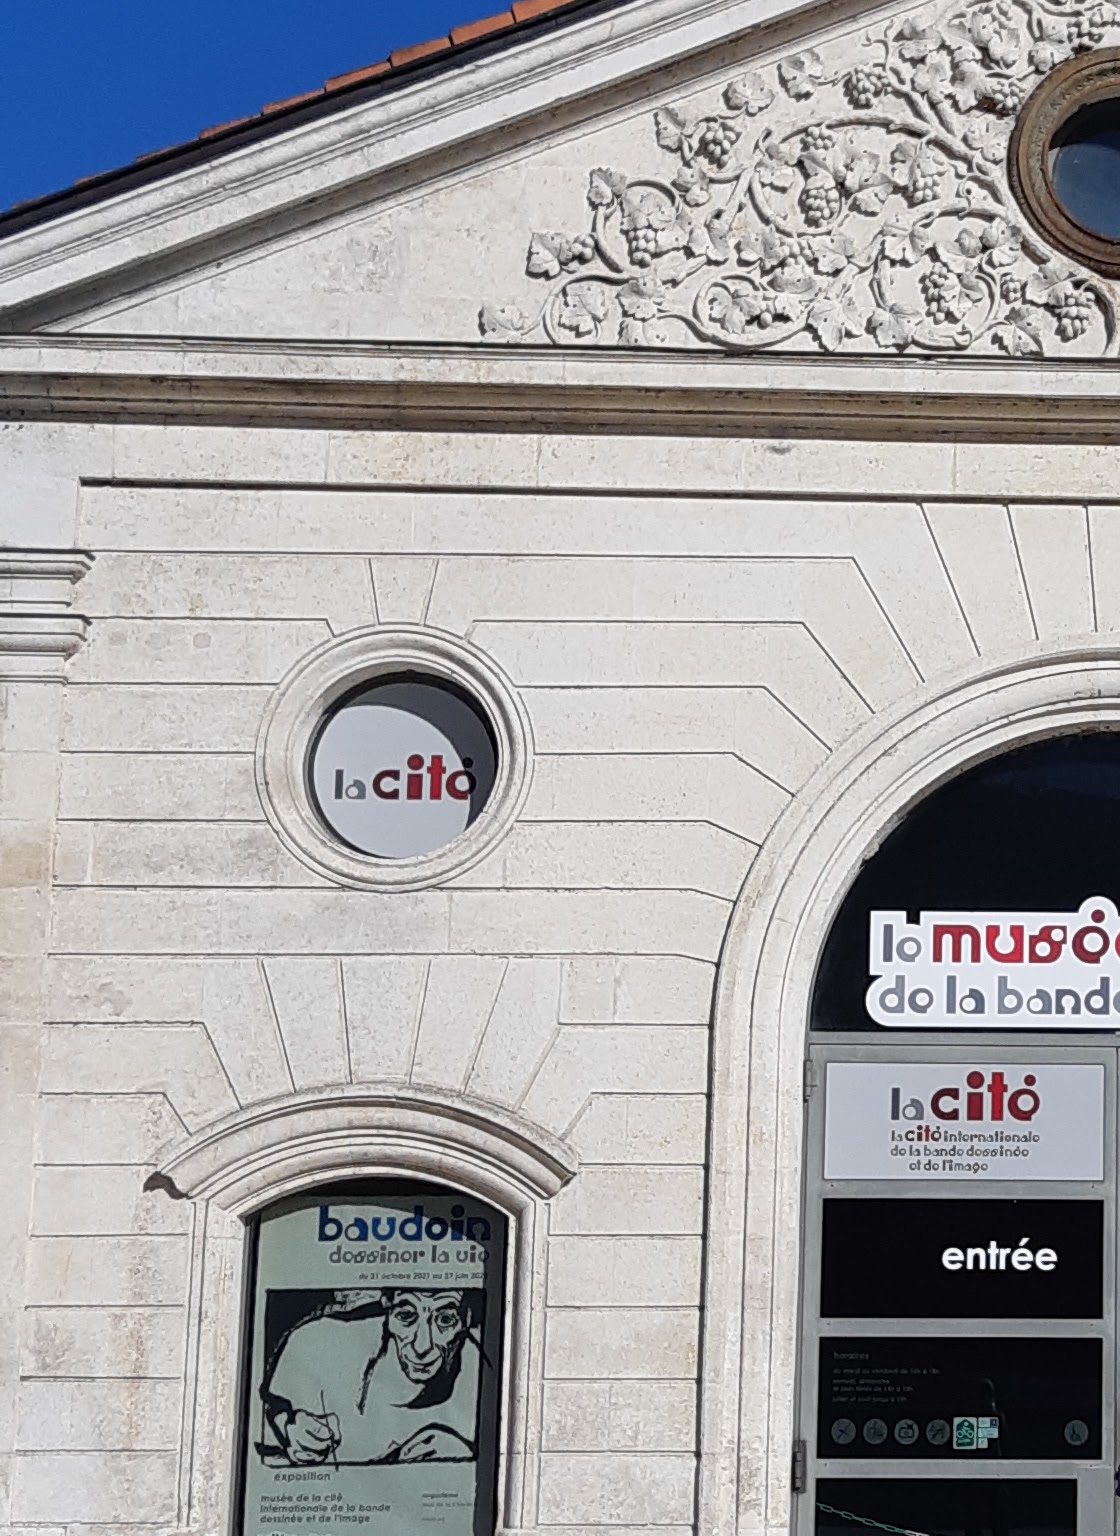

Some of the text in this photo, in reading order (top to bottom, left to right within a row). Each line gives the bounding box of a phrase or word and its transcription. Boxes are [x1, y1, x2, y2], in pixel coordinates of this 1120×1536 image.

[334, 769, 366, 800] la
[946, 975, 986, 1015] la
[891, 1087, 925, 1121] la
[891, 1130, 903, 1142] la
[909, 1145, 921, 1157] la
[318, 1204, 491, 1242] baudoin
[431, 1244, 450, 1263] la
[942, 1237, 1058, 1271] entrée
[274, 1471, 331, 1482] exposition
[296, 1493, 309, 1502] de
